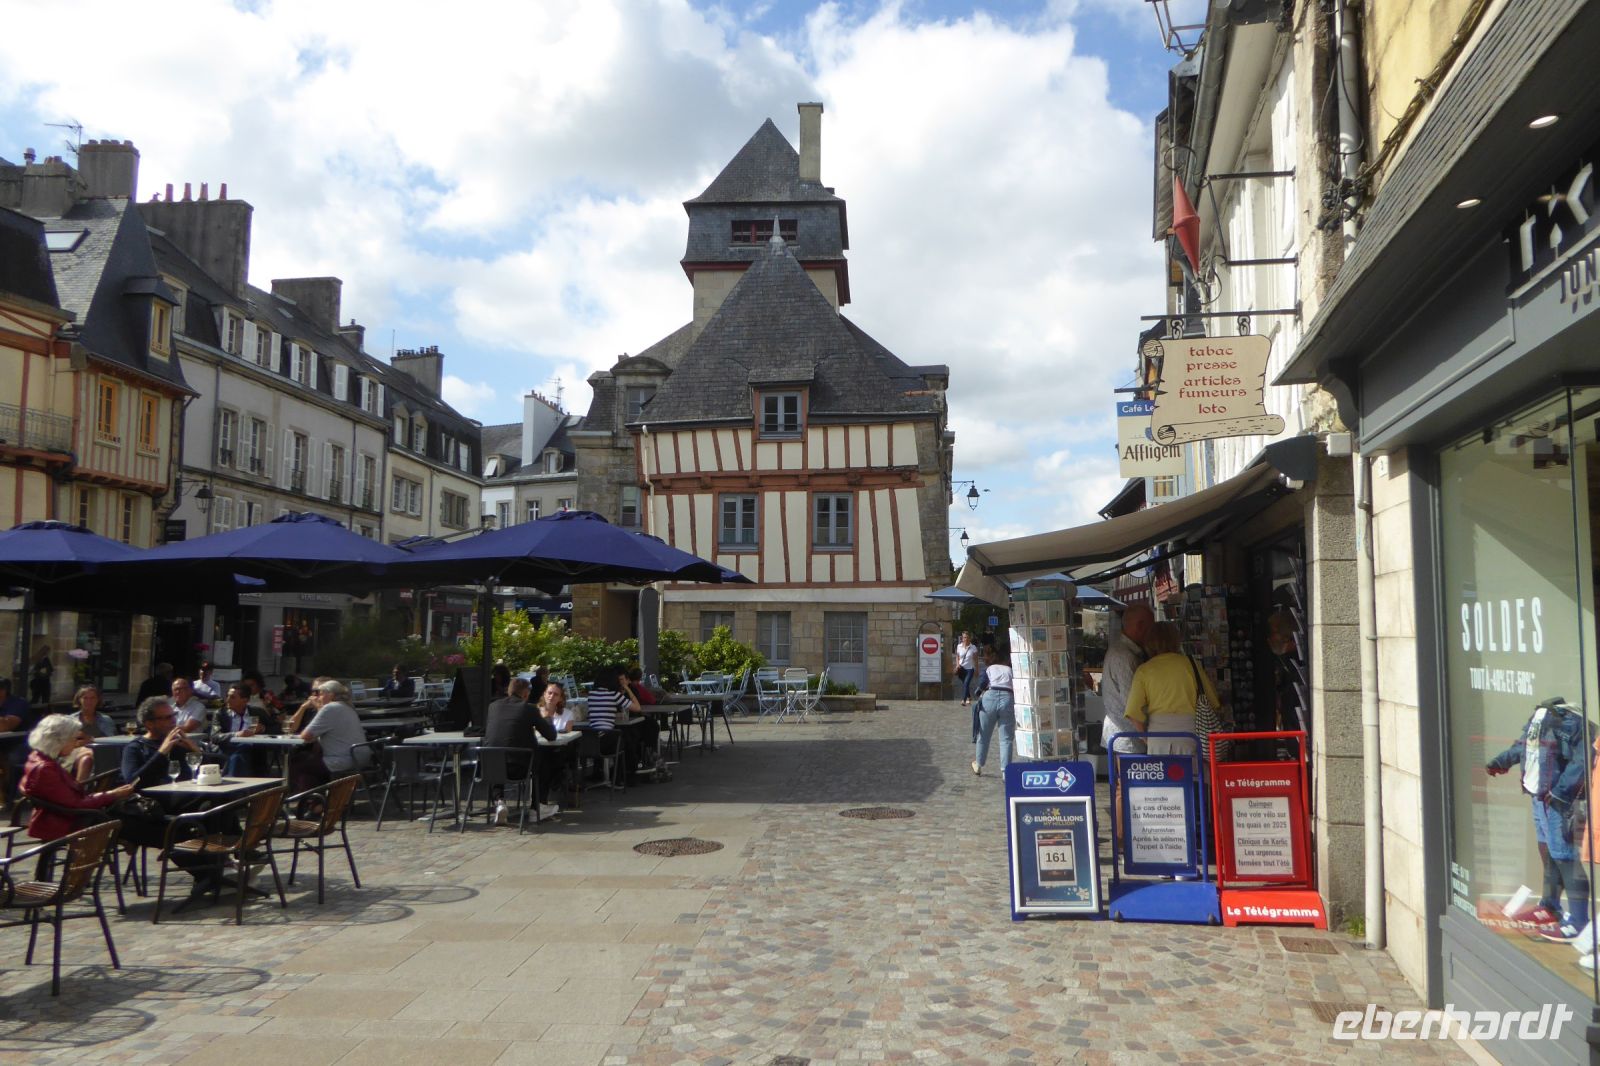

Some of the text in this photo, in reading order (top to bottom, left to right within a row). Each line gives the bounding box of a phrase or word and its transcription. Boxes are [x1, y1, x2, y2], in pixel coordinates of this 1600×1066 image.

[1189, 345, 1234, 358] tabac
[1186, 360, 1238, 373] presse
[1183, 374, 1242, 388] articles
[1178, 387, 1248, 400] fumeurs
[1121, 404, 1143, 414] Café
[1198, 403, 1228, 414] loto
[1122, 443, 1182, 462] Affligem
[1461, 596, 1543, 654] SOLDES
[1131, 761, 1165, 771] ouest
[1126, 768, 1165, 780] france
[1025, 774, 1051, 786] FDJ
[1237, 778, 1291, 788] Télégramme
[1247, 800, 1273, 809] Quimper
[1263, 810, 1276, 818] vélo
[1246, 822, 1262, 830] quais
[1045, 852, 1067, 863] 161
[1255, 850, 1282, 858] urgences
[1226, 905, 1320, 918] Le Télégramme
